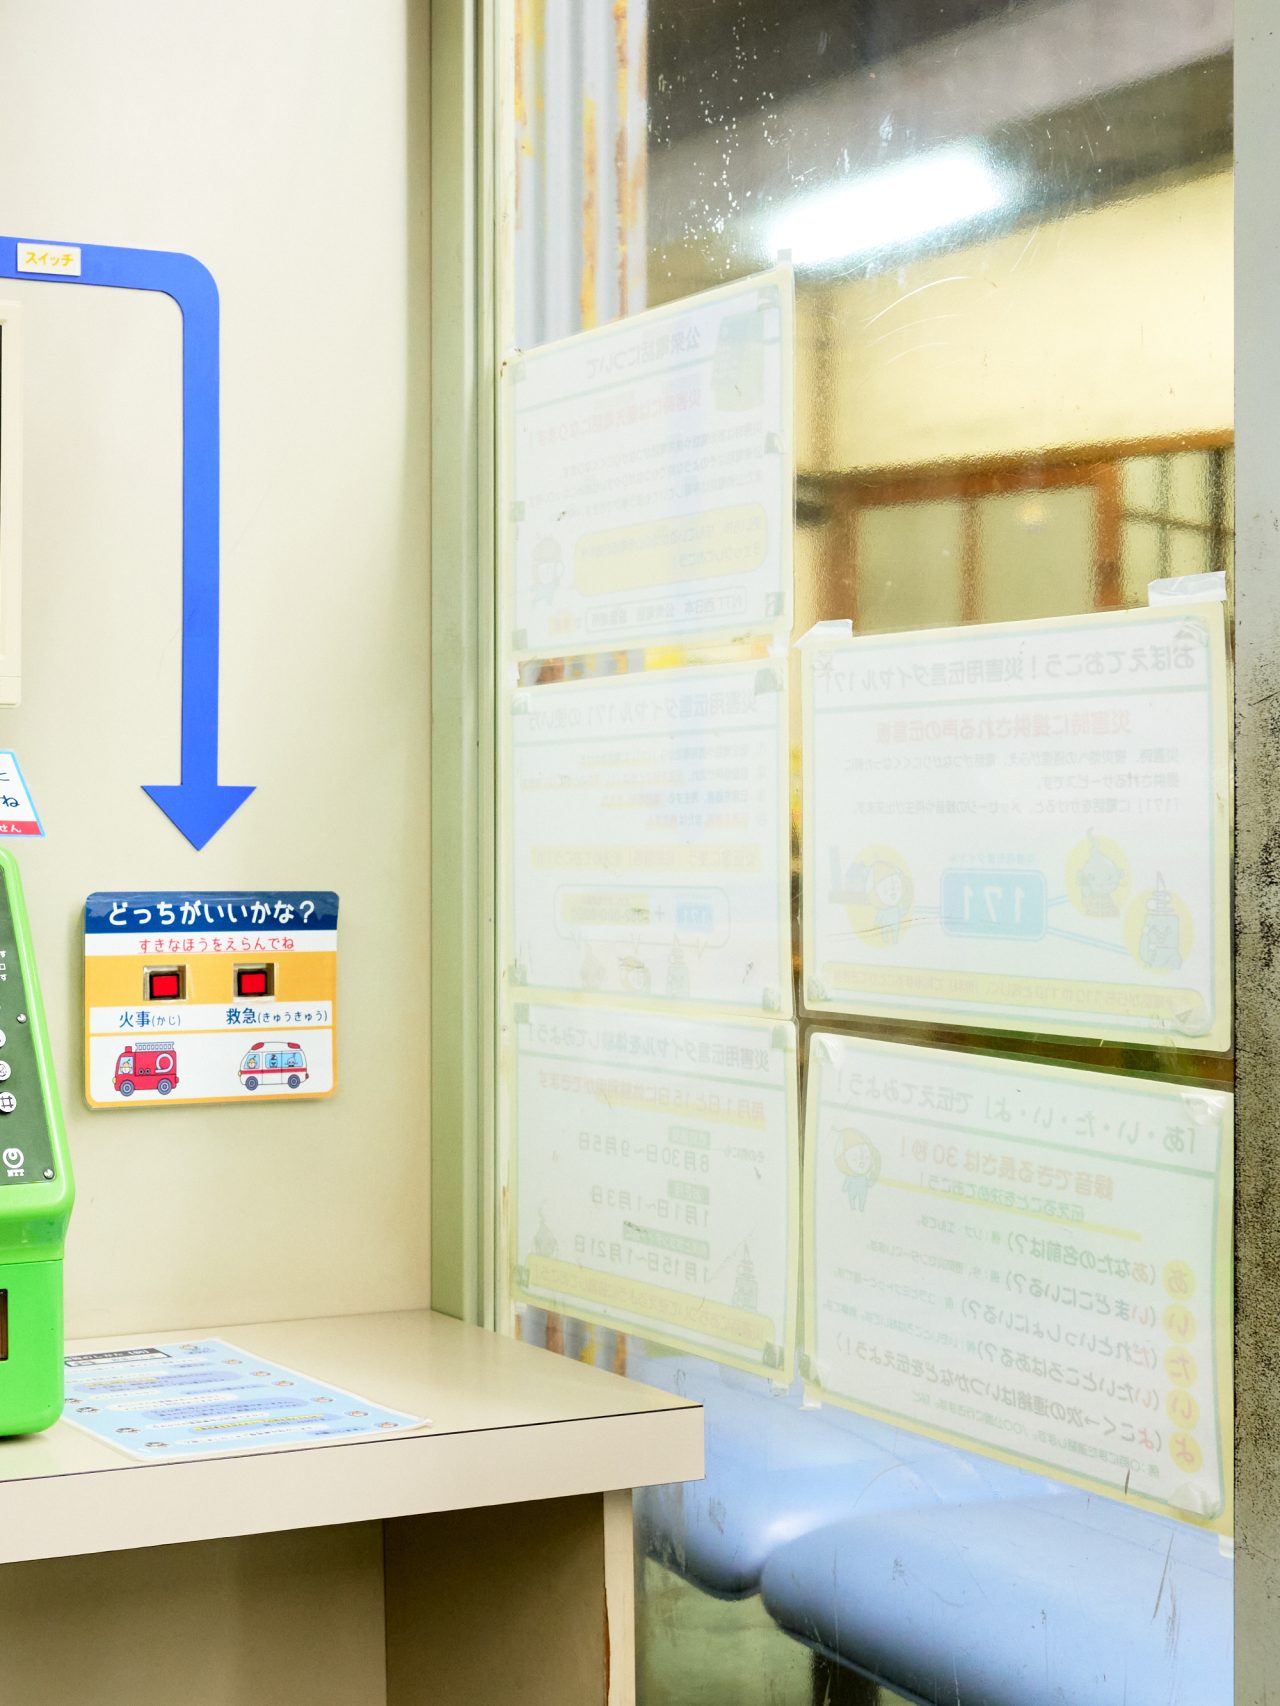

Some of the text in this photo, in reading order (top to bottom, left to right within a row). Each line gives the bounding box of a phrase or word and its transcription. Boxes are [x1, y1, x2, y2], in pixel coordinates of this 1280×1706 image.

[26, 251, 74, 267] スイッチ
[109, 900, 315, 926] どっちがいいかな？
[138, 937, 295, 952] すきなほうをえらんでね
[120, 1008, 328, 1027] 火事(かじ) 救急(きゅうきゅう)
[7, 1169, 24, 1177] NTT
